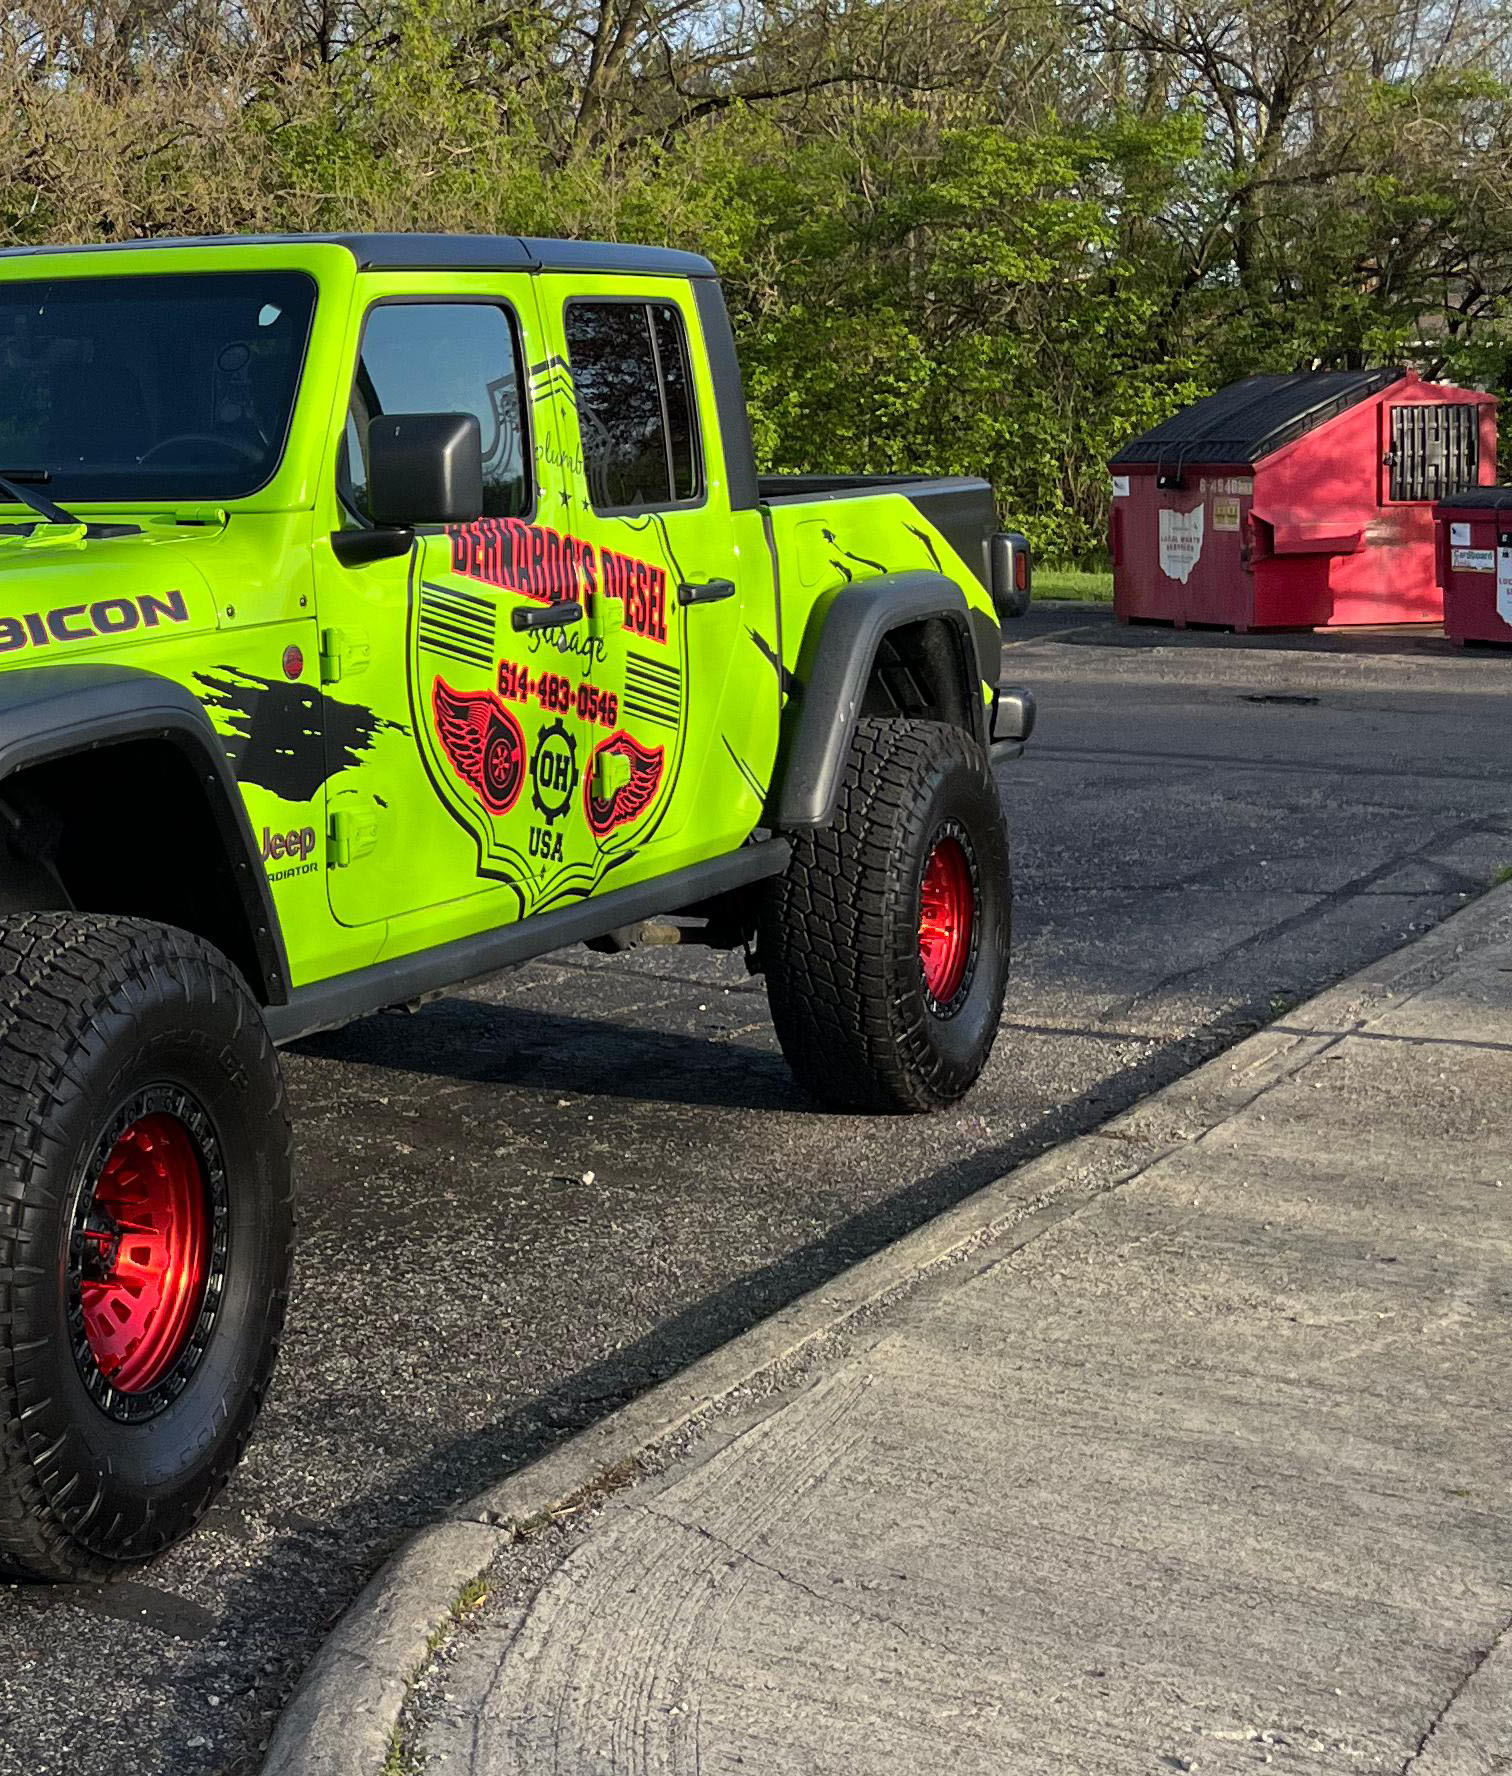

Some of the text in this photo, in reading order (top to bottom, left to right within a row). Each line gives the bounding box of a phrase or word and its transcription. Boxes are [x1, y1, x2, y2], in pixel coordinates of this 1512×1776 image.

[600, 546, 667, 645] DIESEL
[539, 749, 571, 793] OH
[263, 826, 316, 863] Jeep
[529, 825, 564, 863] USA
